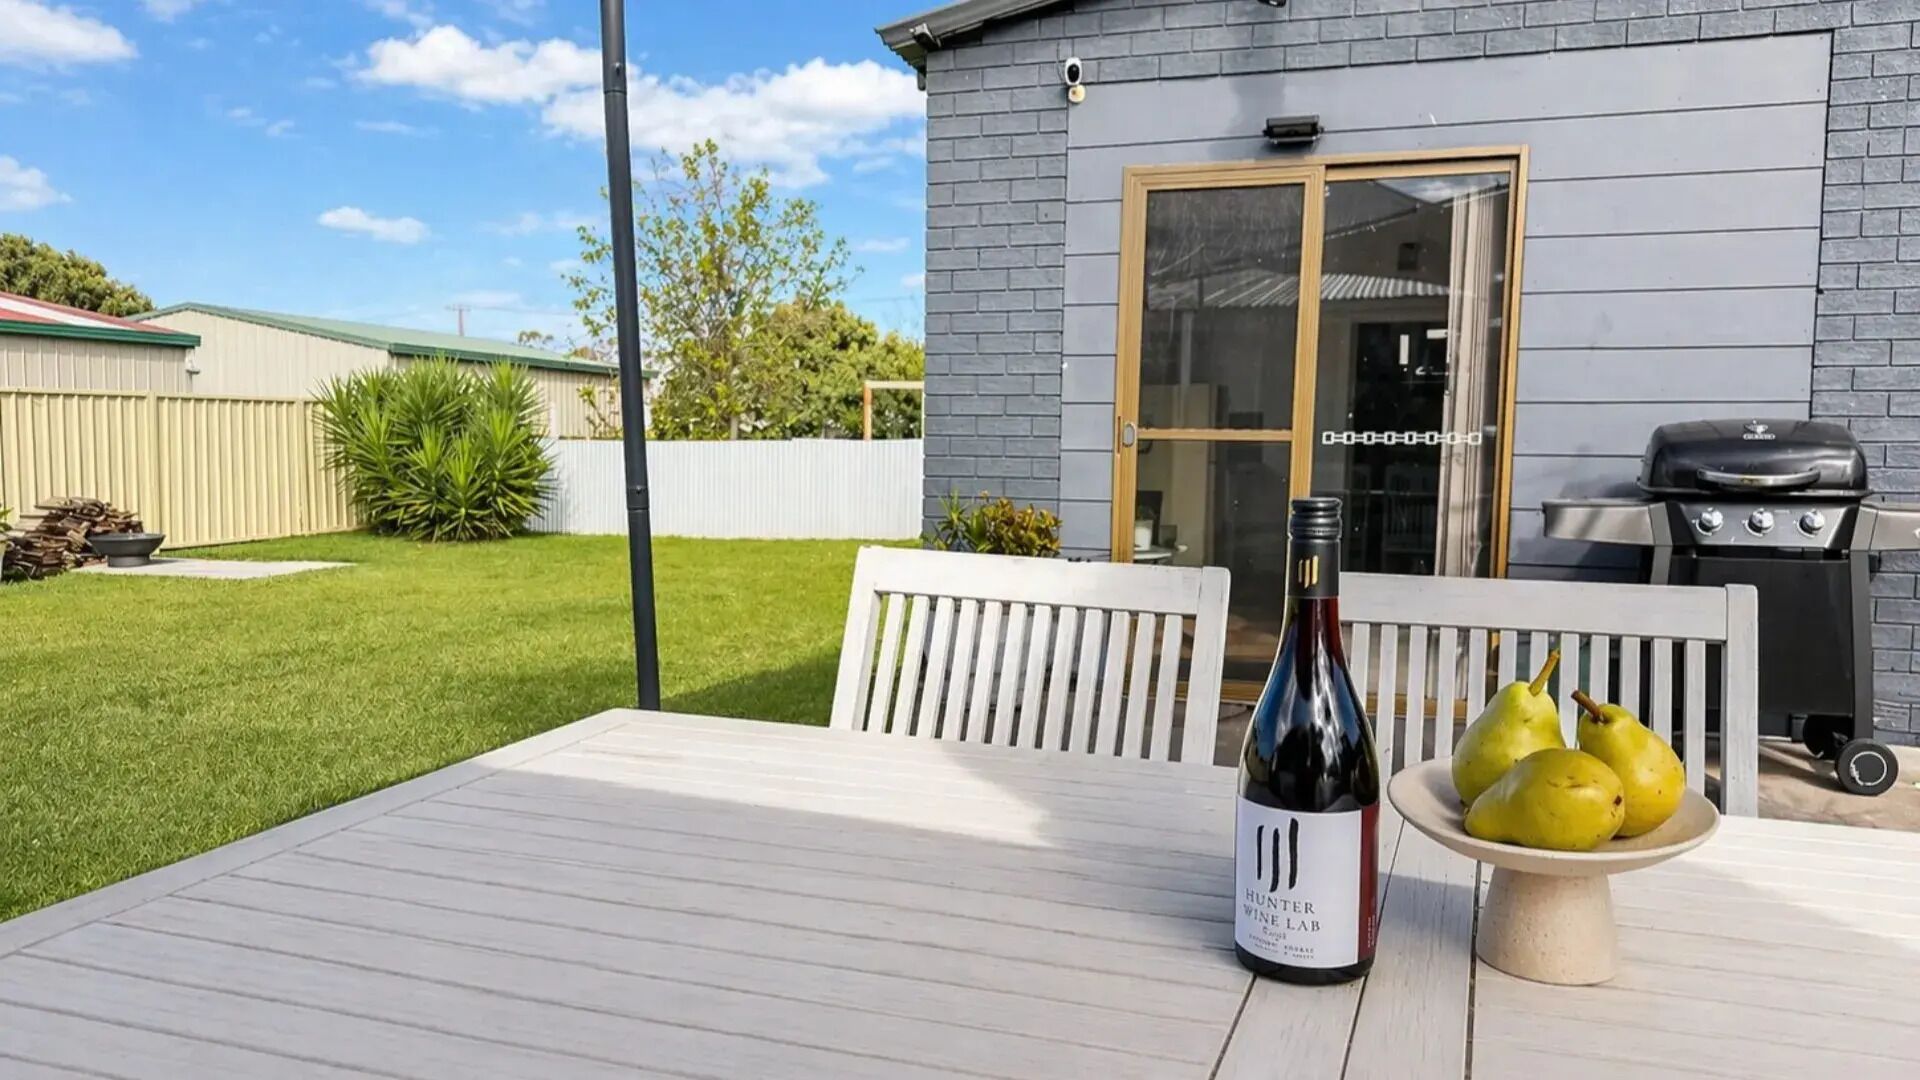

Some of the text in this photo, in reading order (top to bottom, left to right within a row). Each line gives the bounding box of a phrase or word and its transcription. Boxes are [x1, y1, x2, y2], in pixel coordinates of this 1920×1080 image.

[1245, 887, 1315, 915] HUNTER
[1243, 903, 1321, 932] WINE LAB
